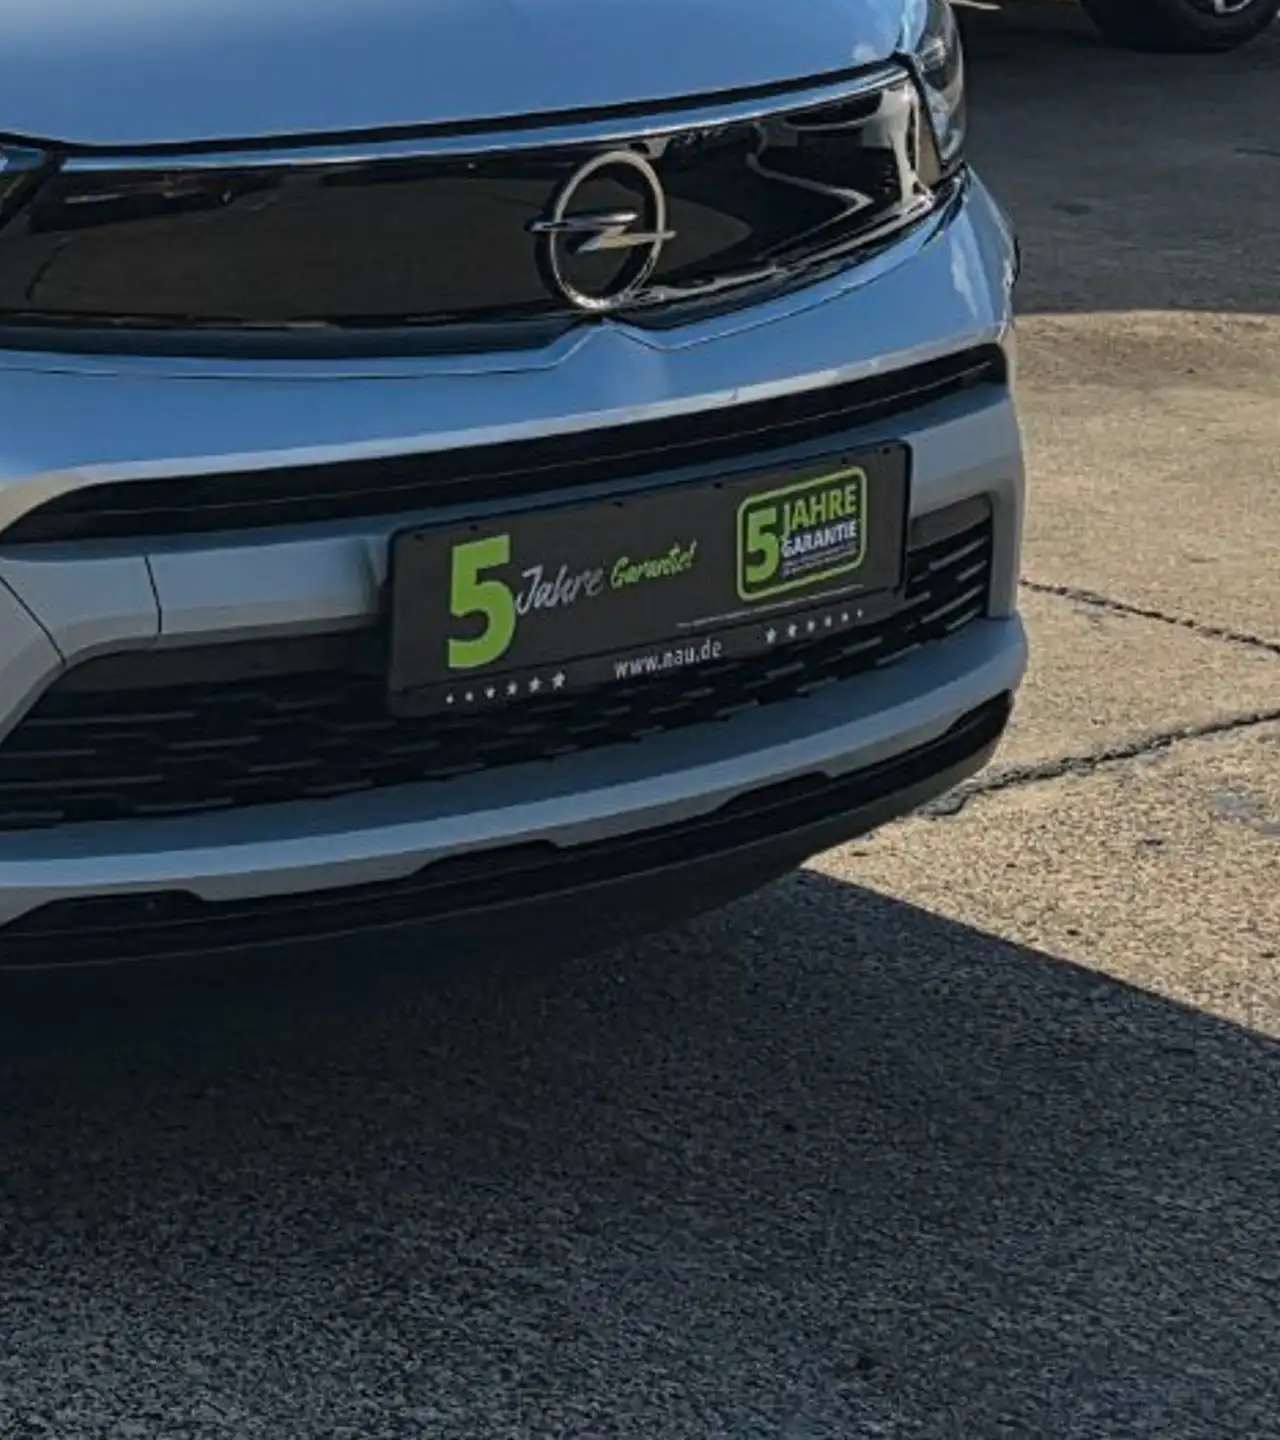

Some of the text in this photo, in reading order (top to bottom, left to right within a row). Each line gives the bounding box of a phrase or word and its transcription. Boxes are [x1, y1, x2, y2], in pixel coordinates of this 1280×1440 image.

[746, 507, 780, 583] 5
[781, 483, 858, 540] JAHRE
[780, 519, 858, 559] GARANTIE
[449, 534, 517, 668] 5
[516, 563, 605, 615] Jahre
[613, 639, 723, 680] www.nau.de
